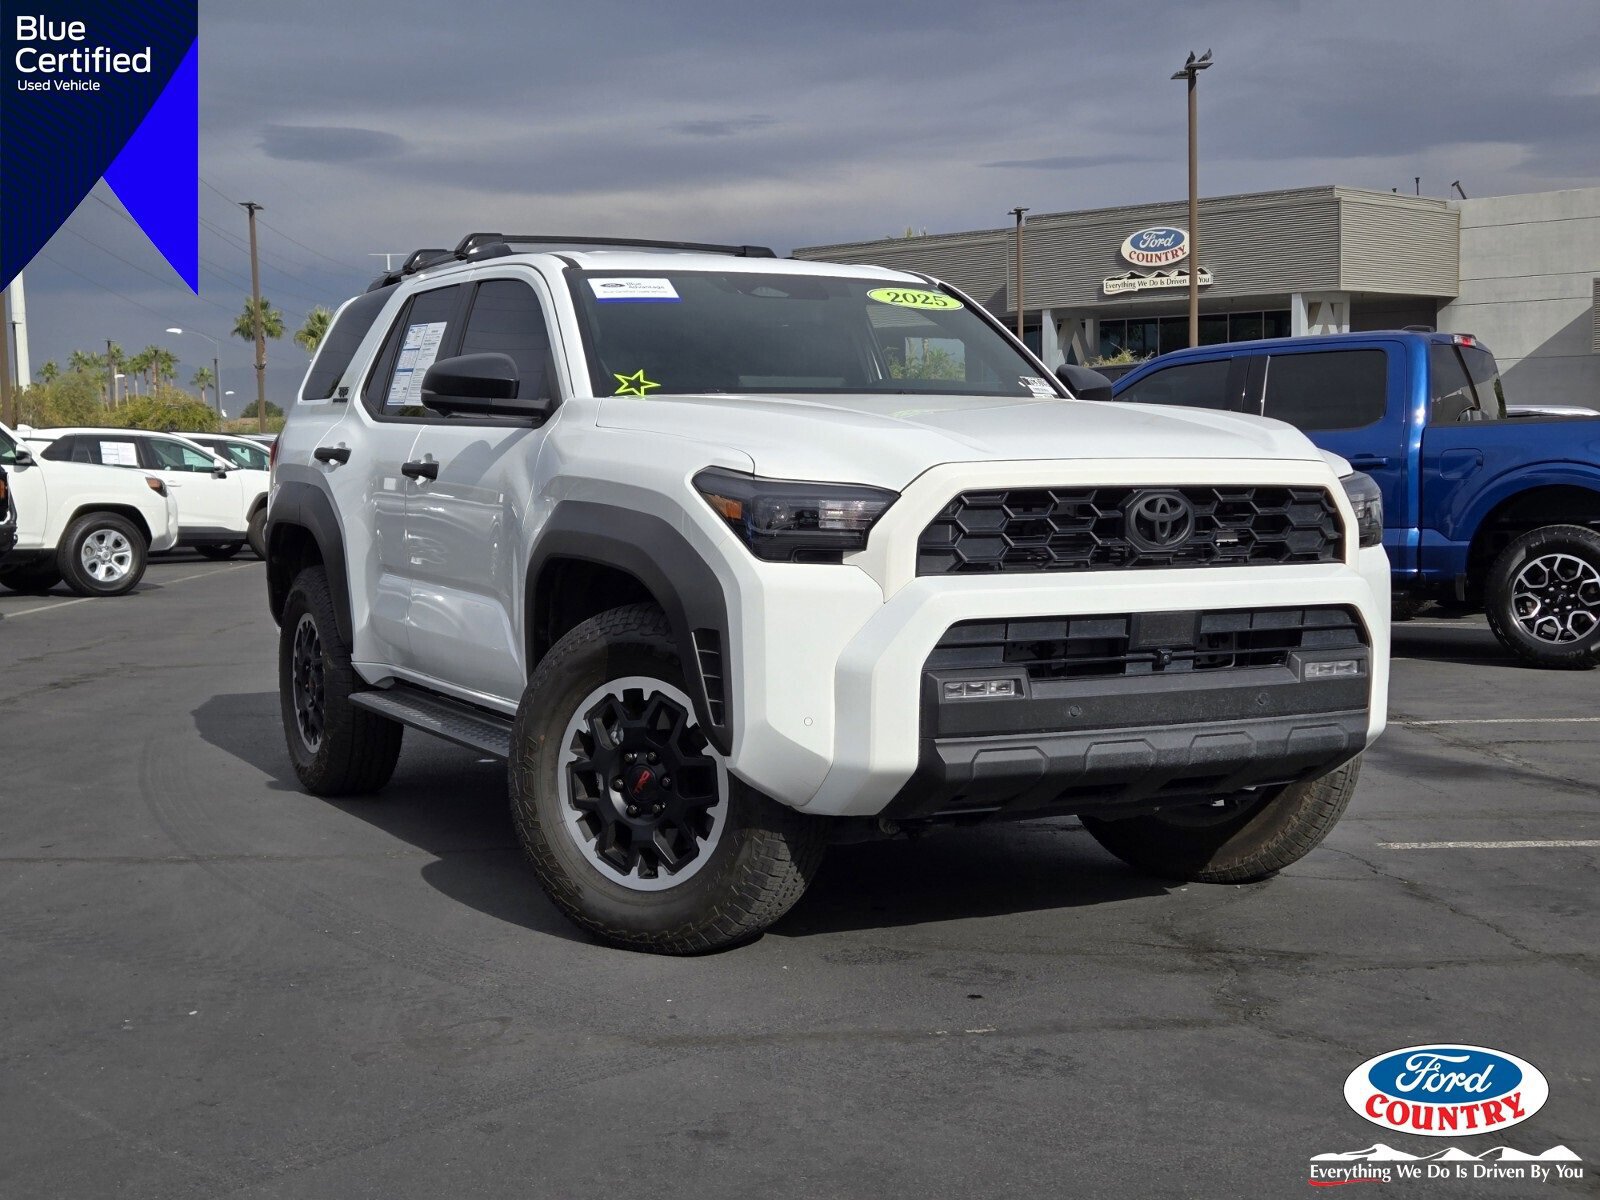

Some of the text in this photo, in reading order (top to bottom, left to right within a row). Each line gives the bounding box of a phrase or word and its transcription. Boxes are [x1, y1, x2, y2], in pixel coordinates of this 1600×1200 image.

[1139, 230, 1175, 249] Ford
[1129, 245, 1186, 263] COUNTRY
[1105, 280, 1136, 290] Everything
[1149, 279, 1158, 287] Do
[1166, 278, 1187, 286] Driven
[887, 292, 948, 306] 2025
